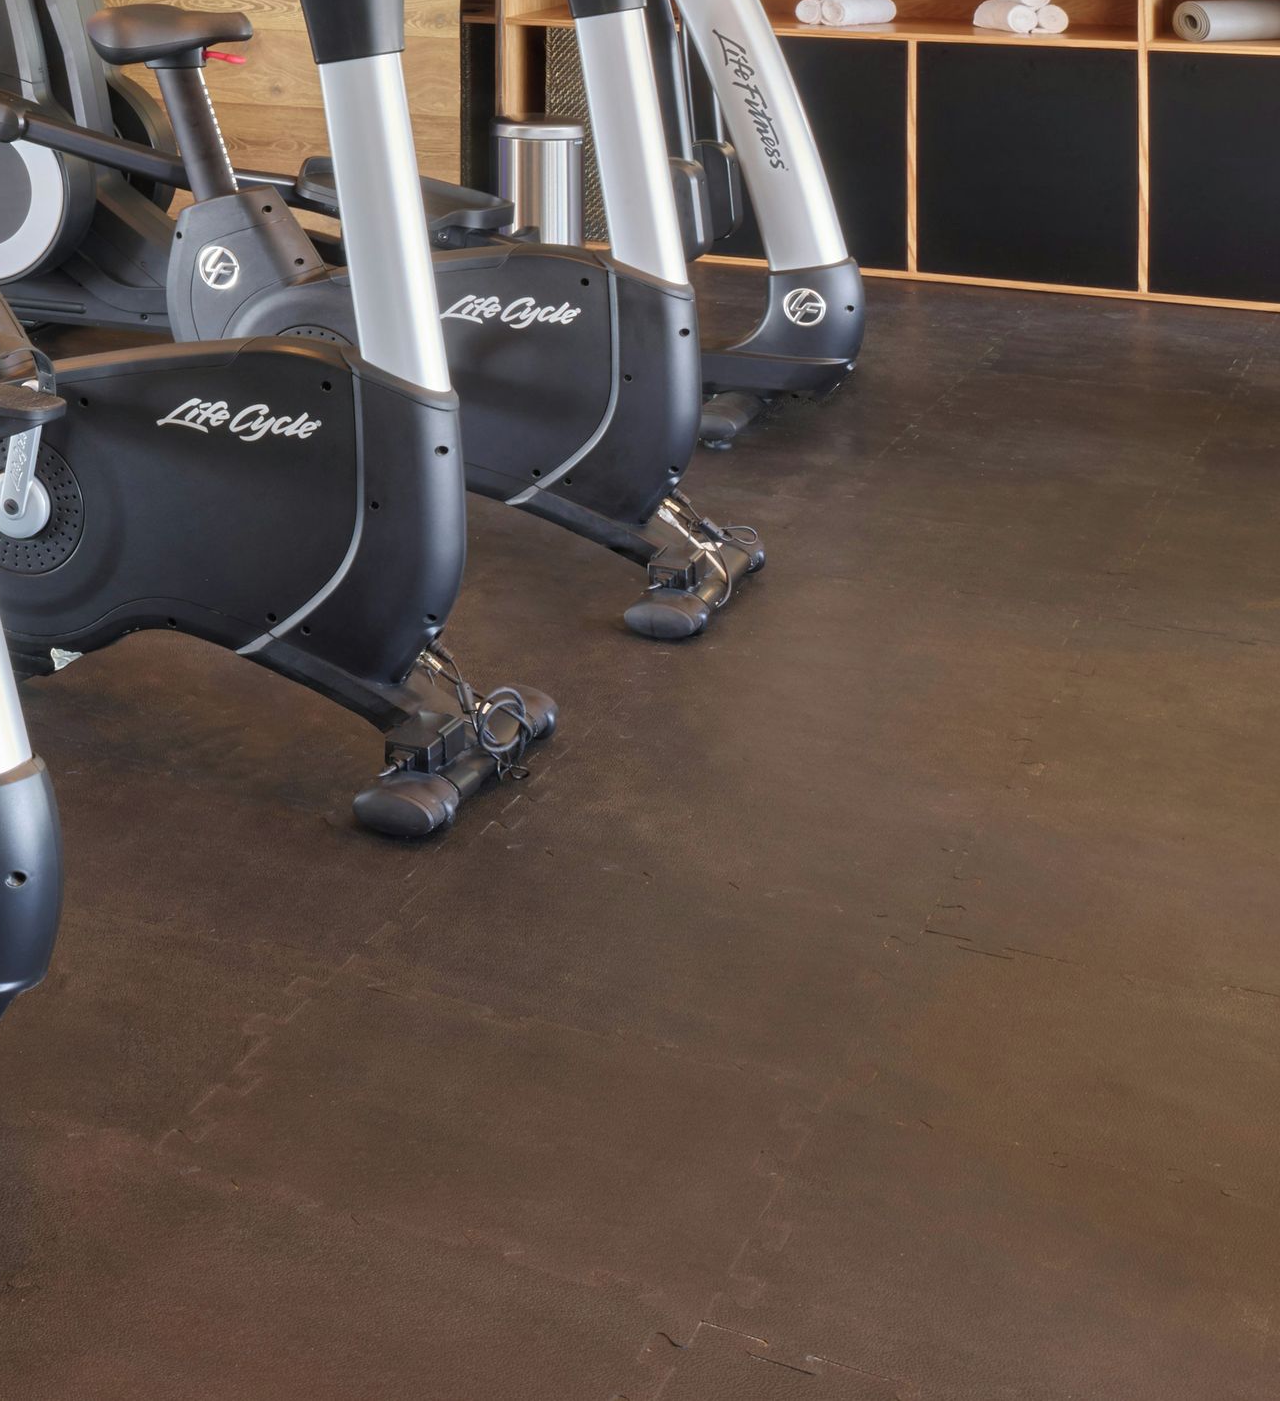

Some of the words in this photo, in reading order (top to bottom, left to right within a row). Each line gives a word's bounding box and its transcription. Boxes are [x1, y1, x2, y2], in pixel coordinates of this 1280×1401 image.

[712, 28, 755, 82] Life
[732, 81, 785, 170] Fitness
[440, 294, 502, 324] Life
[156, 397, 231, 434] Life
[228, 403, 319, 442] Cycle
